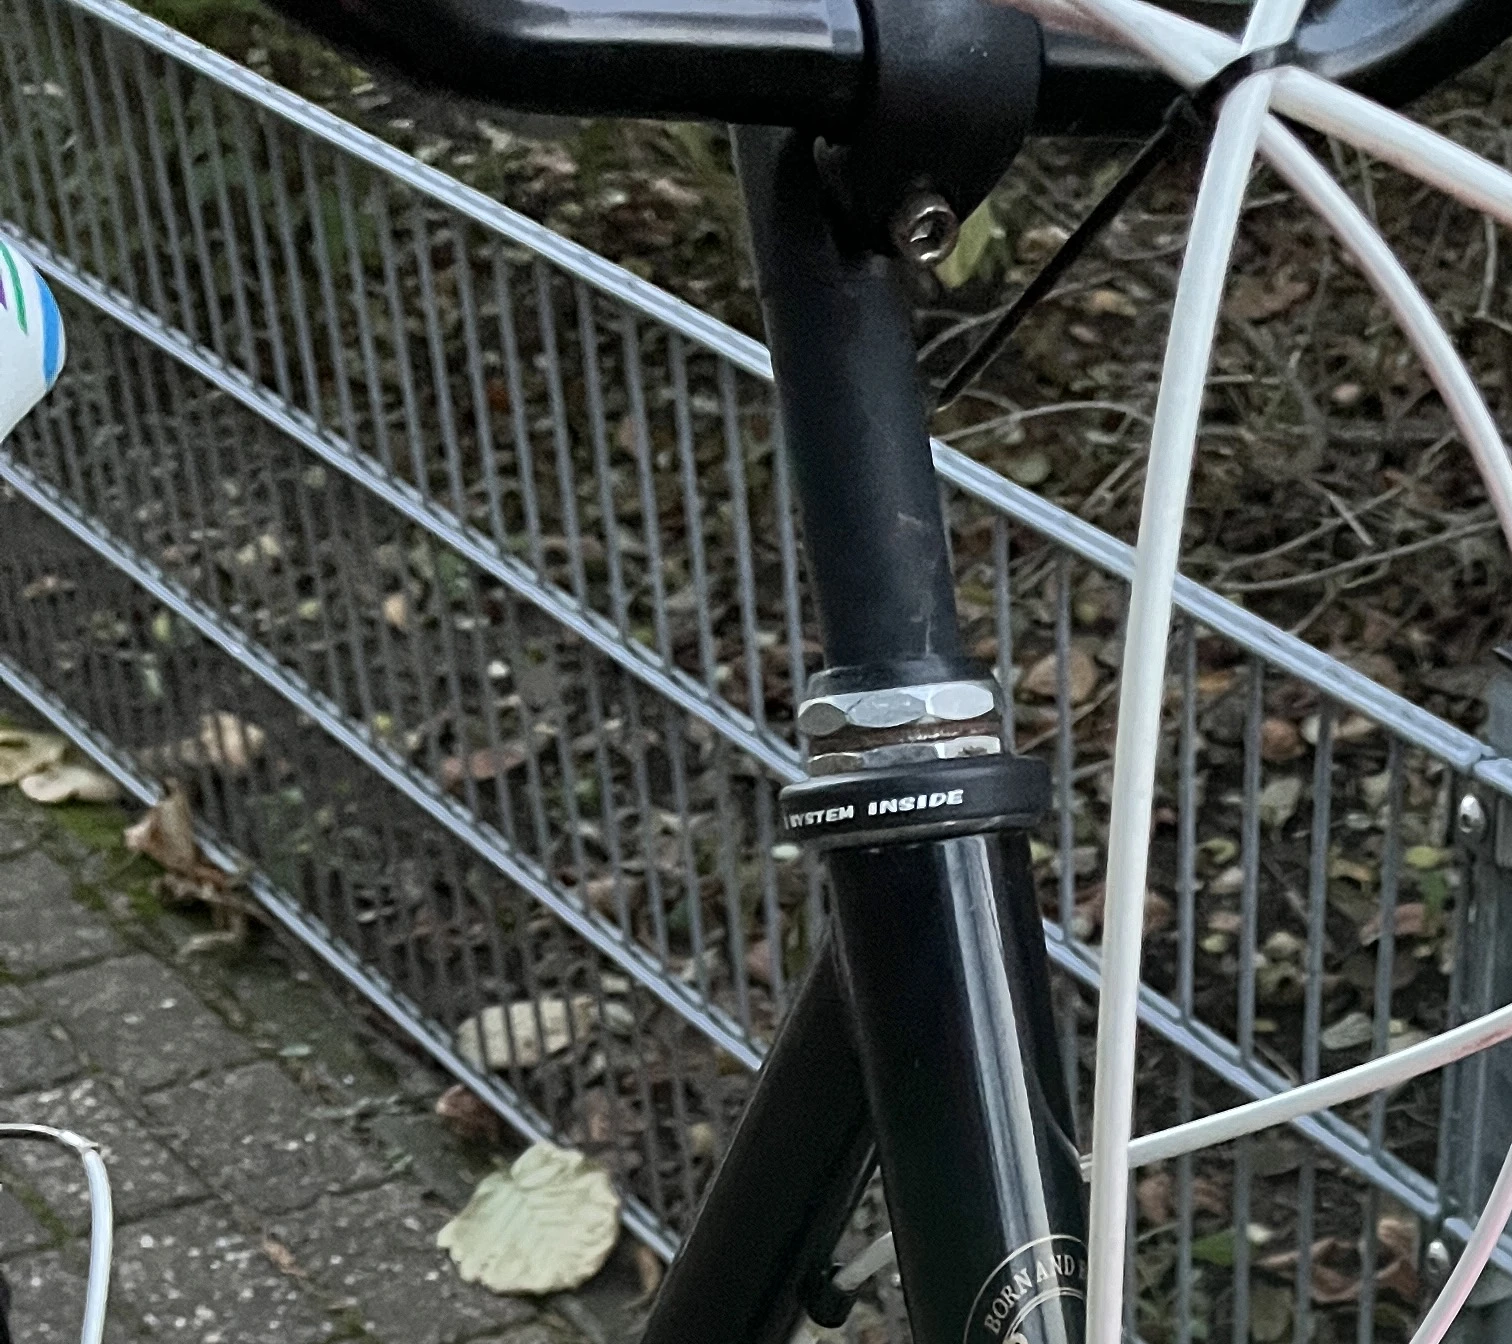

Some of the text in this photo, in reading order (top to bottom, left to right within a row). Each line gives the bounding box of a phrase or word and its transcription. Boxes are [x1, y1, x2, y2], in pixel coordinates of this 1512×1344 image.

[868, 789, 964, 816] INSIDE
[984, 1268, 1033, 1335] BORN
[1037, 1254, 1075, 1283] AND
